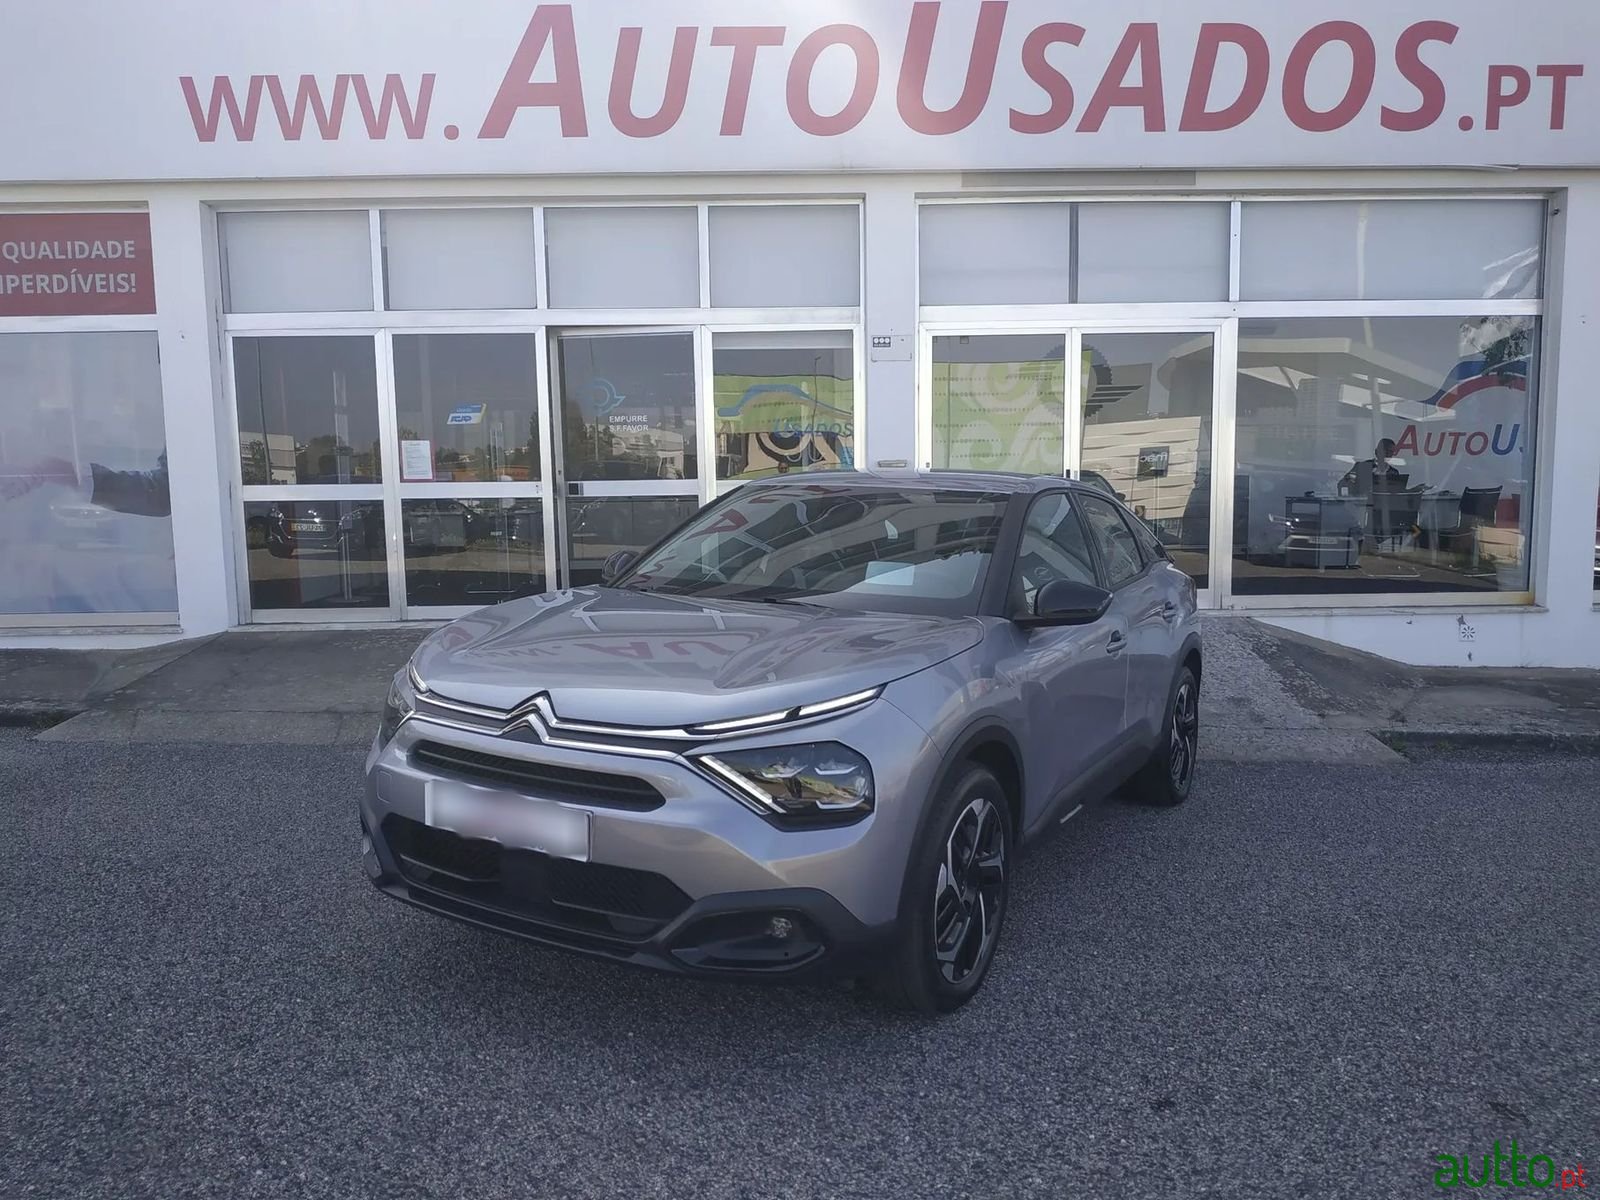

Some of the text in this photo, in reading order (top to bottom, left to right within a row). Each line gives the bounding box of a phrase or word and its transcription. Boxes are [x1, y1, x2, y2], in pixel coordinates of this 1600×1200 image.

[2, 240, 136, 263] QUALIDADE
[0, 268, 137, 294] PERDÍVEIS!
[609, 415, 649, 423] EMPURRE
[1392, 424, 1524, 456] AUTOU
